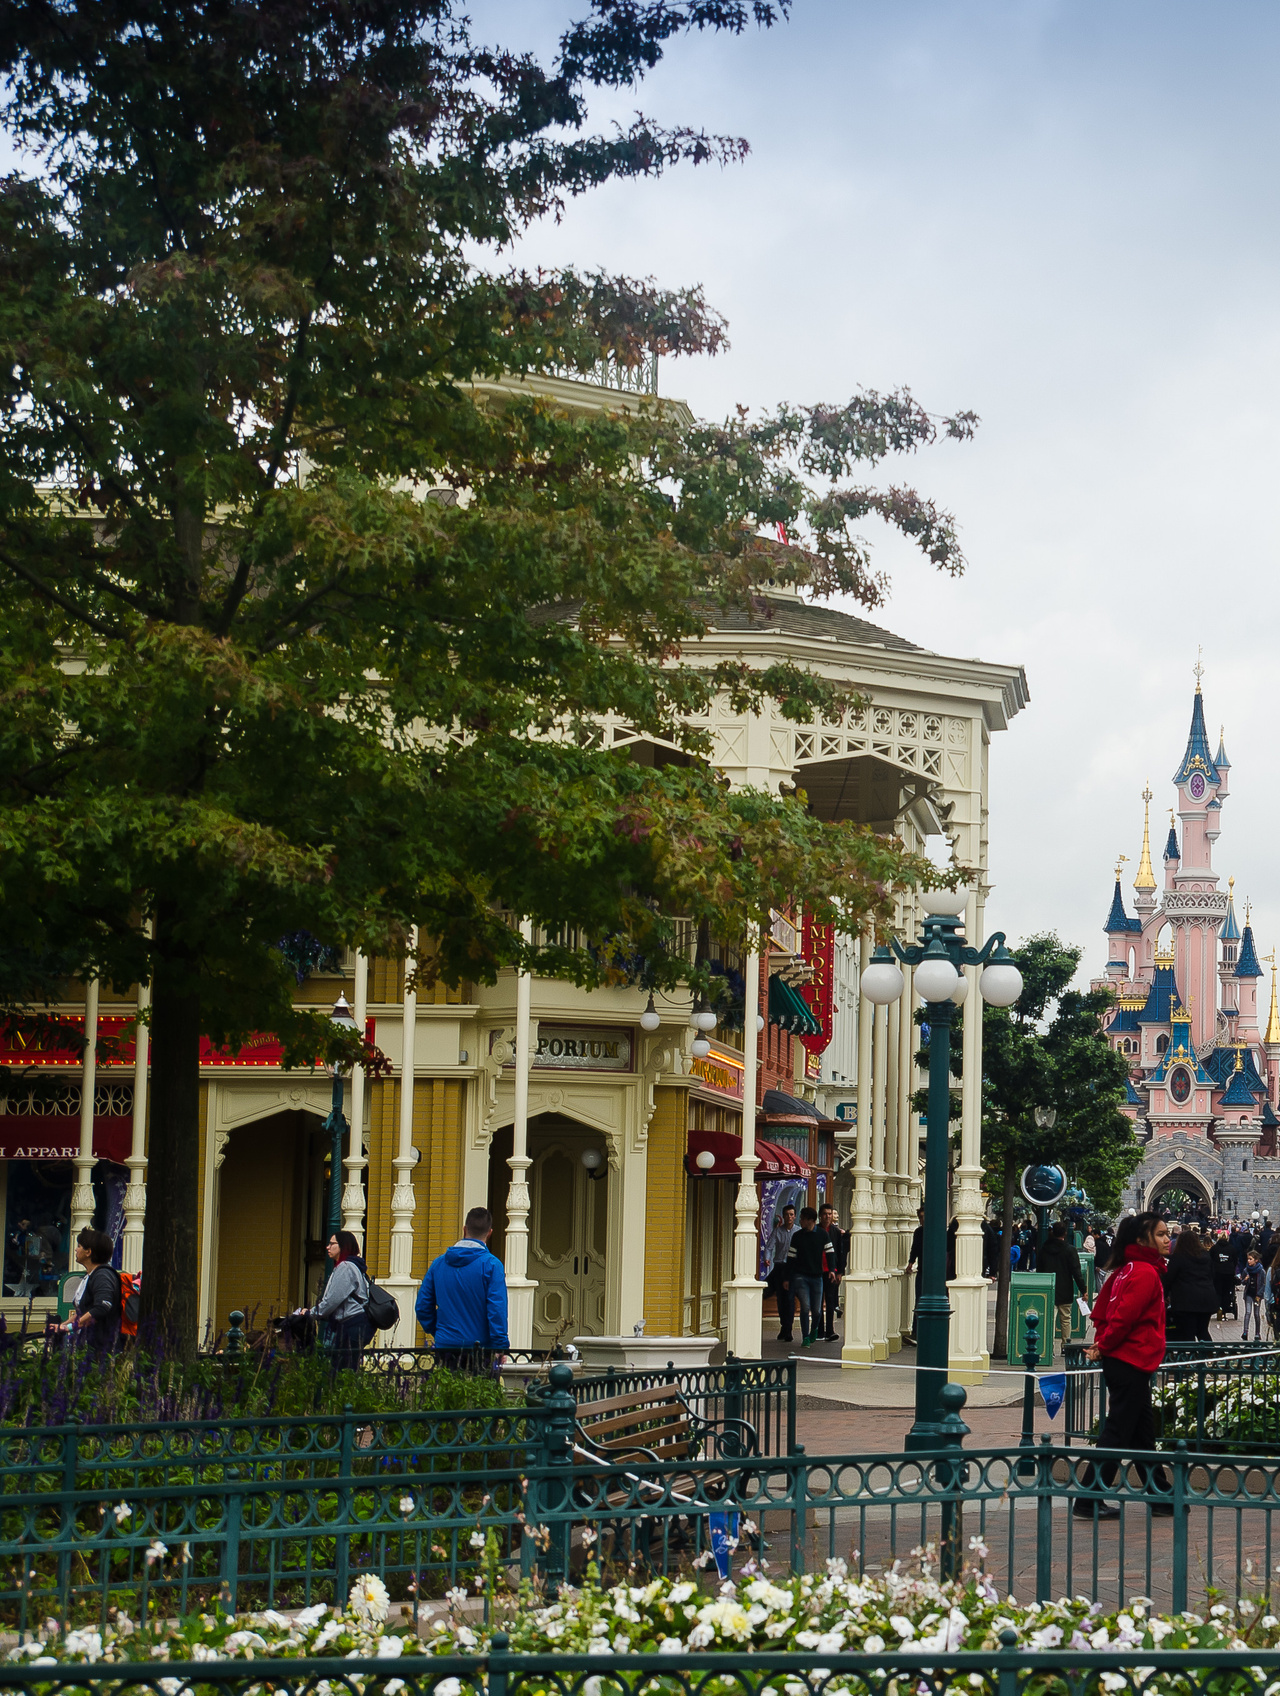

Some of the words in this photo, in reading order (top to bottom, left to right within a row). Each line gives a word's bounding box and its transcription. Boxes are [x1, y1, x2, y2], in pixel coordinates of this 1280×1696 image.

[809, 911, 827, 1032] EMPORIU
[508, 1038, 620, 1059] PORIUM
[13, 1147, 98, 1158] APPAR
